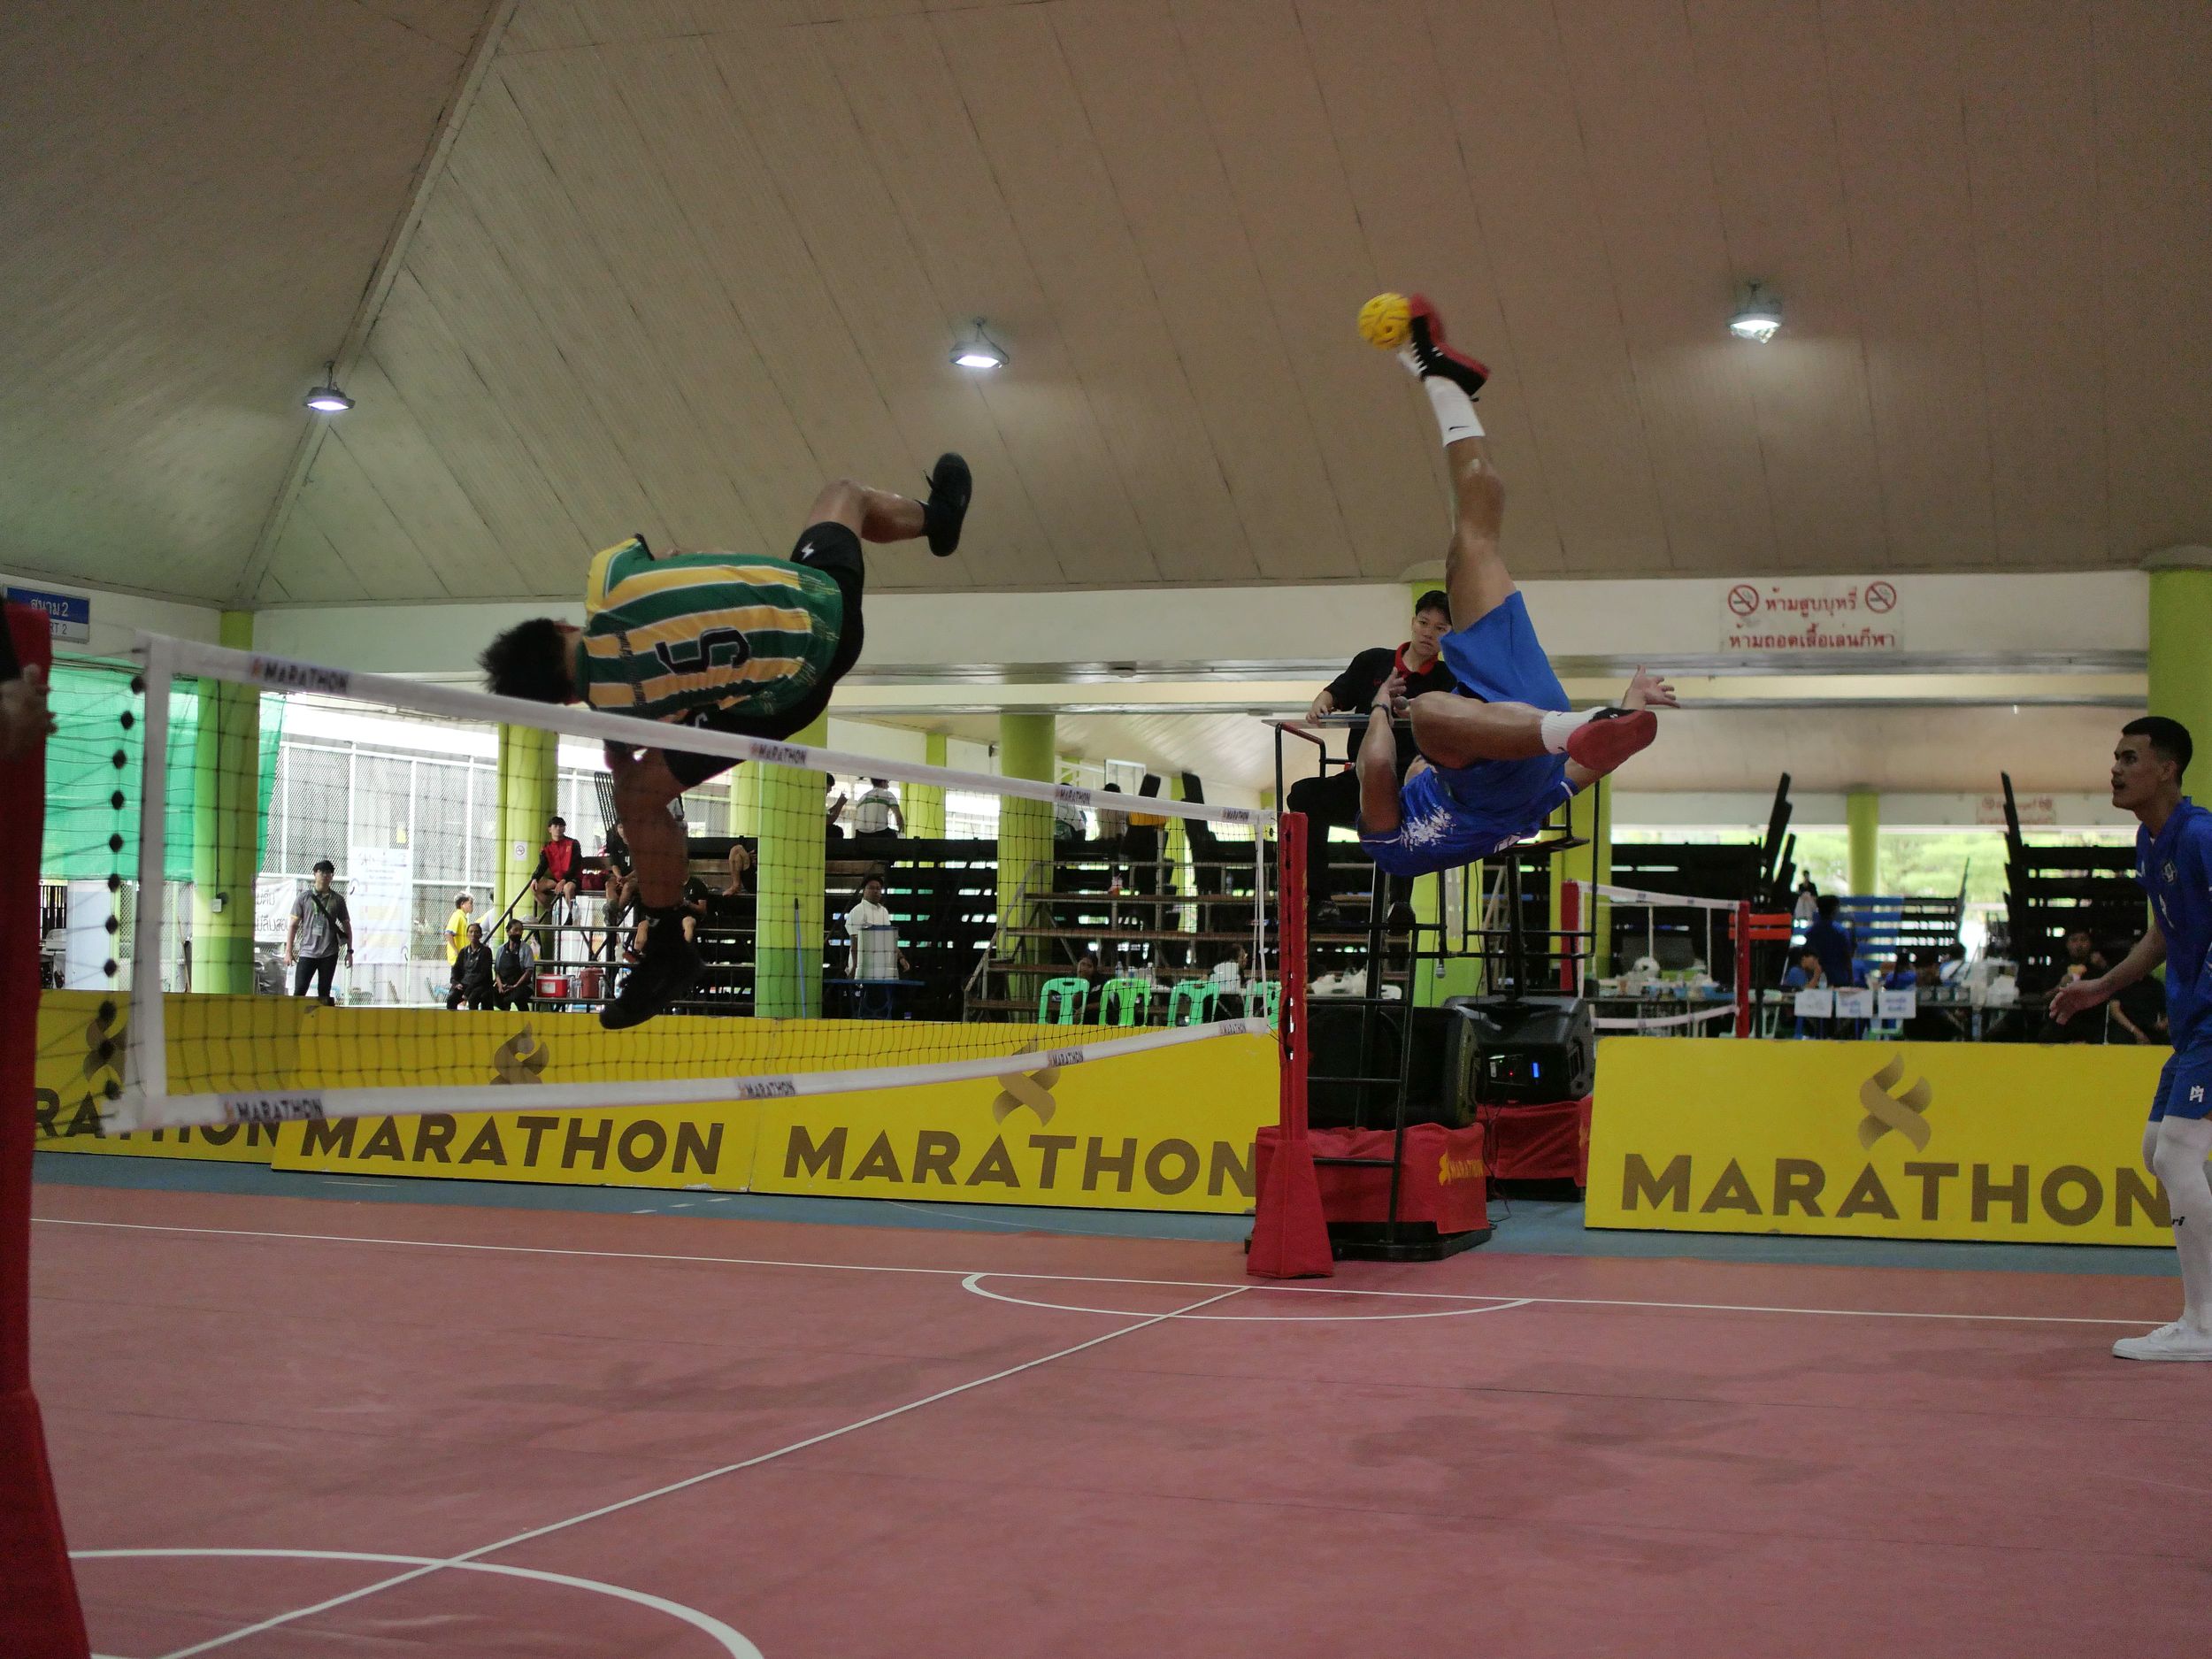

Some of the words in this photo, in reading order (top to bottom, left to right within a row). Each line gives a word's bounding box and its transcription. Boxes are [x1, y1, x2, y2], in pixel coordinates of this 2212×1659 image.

[62, 602, 69, 617] 2
[62, 623, 67, 634] 2
[655, 626, 750, 675] 5
[265, 662, 349, 694] MARATHON
[625, 856, 630, 866] 4
[236, 1098, 324, 1121] MARATHON
[300, 1113, 724, 1175] MARATHON
[783, 1125, 1256, 1197] MARATHON
[1621, 1153, 2173, 1228] MARATHON
